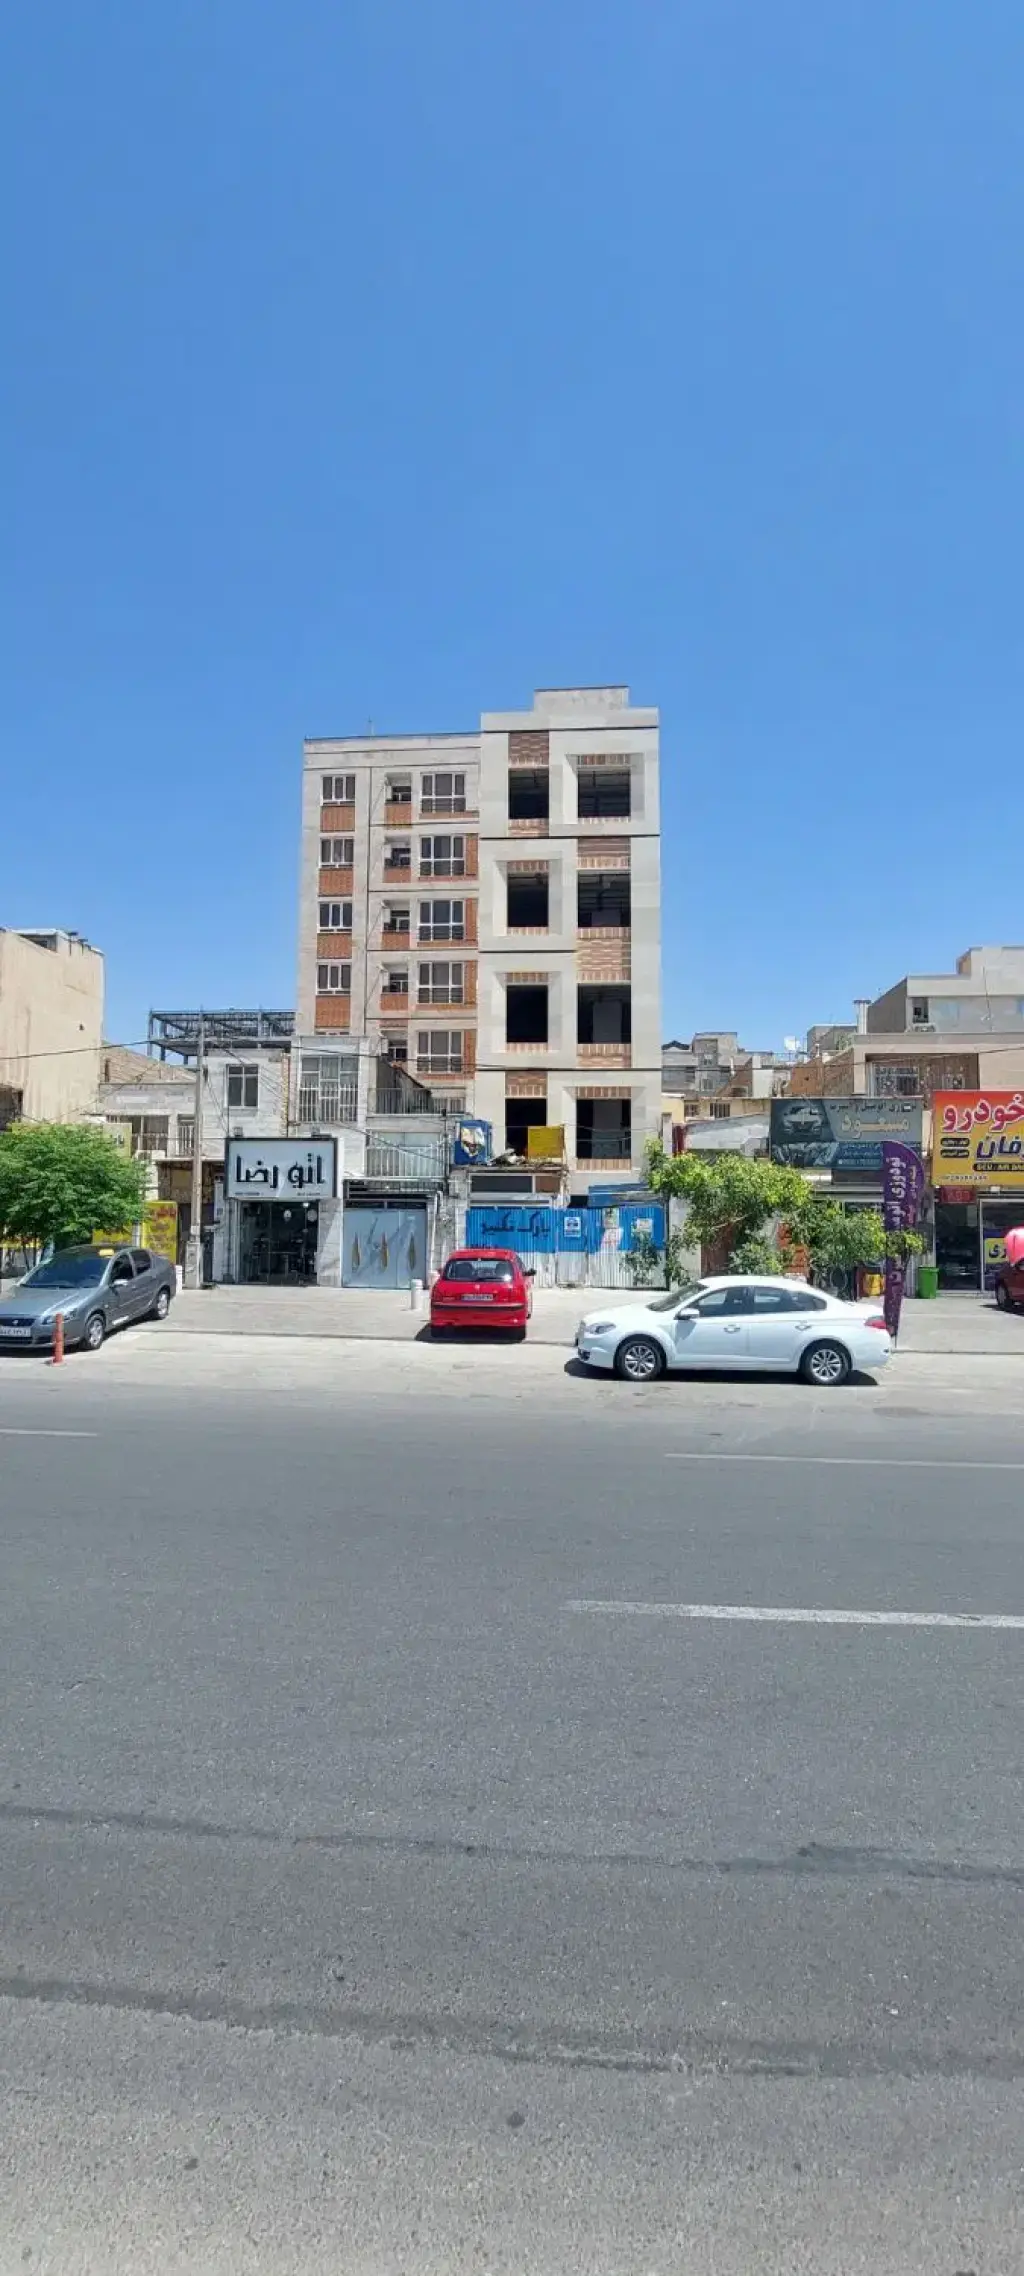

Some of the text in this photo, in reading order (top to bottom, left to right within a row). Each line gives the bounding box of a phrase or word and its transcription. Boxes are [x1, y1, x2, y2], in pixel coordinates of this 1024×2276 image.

[941, 1094, 1024, 1133] خودرو
[976, 1135, 1024, 1159] فان
[236, 1153, 326, 1189] اتو رضا
